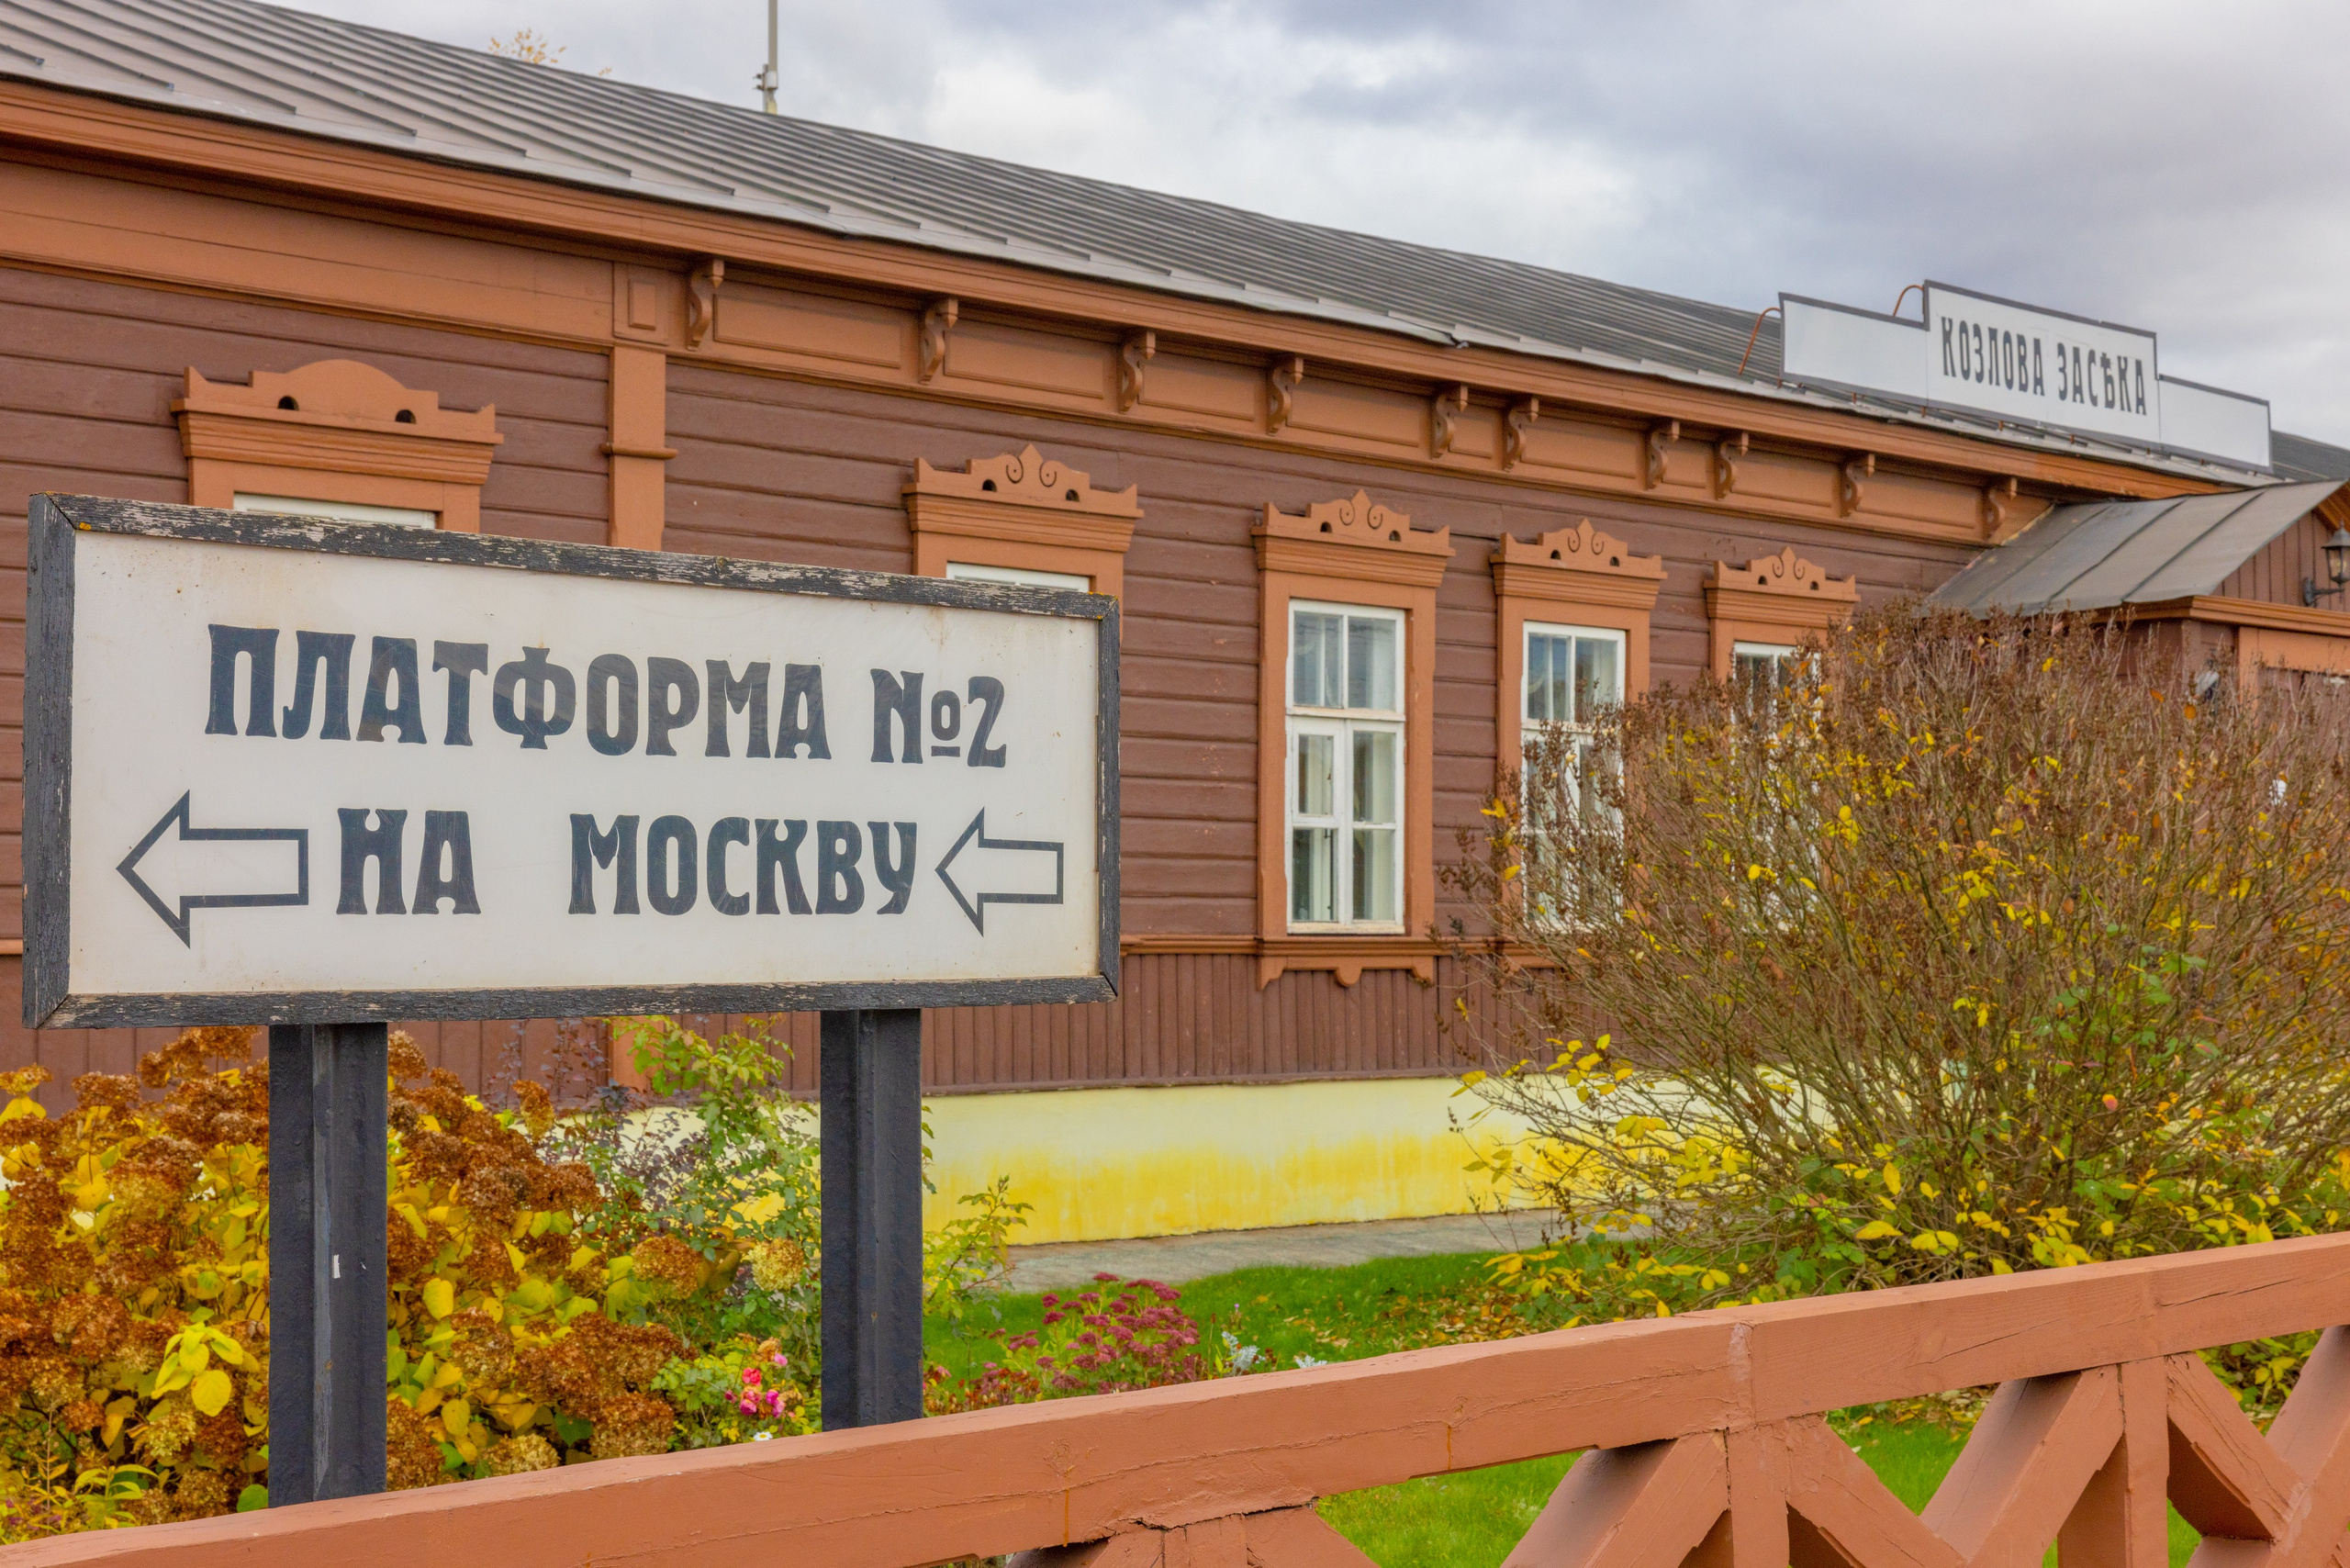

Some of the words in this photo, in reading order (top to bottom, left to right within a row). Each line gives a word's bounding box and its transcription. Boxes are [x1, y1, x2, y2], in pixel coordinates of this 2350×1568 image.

[1941, 316, 2046, 398] КОЗЛОВА
[204, 623, 832, 760] ПЛАТФОРМА
[335, 807, 482, 915] НА
[567, 813, 917, 916] МОСКВУ
